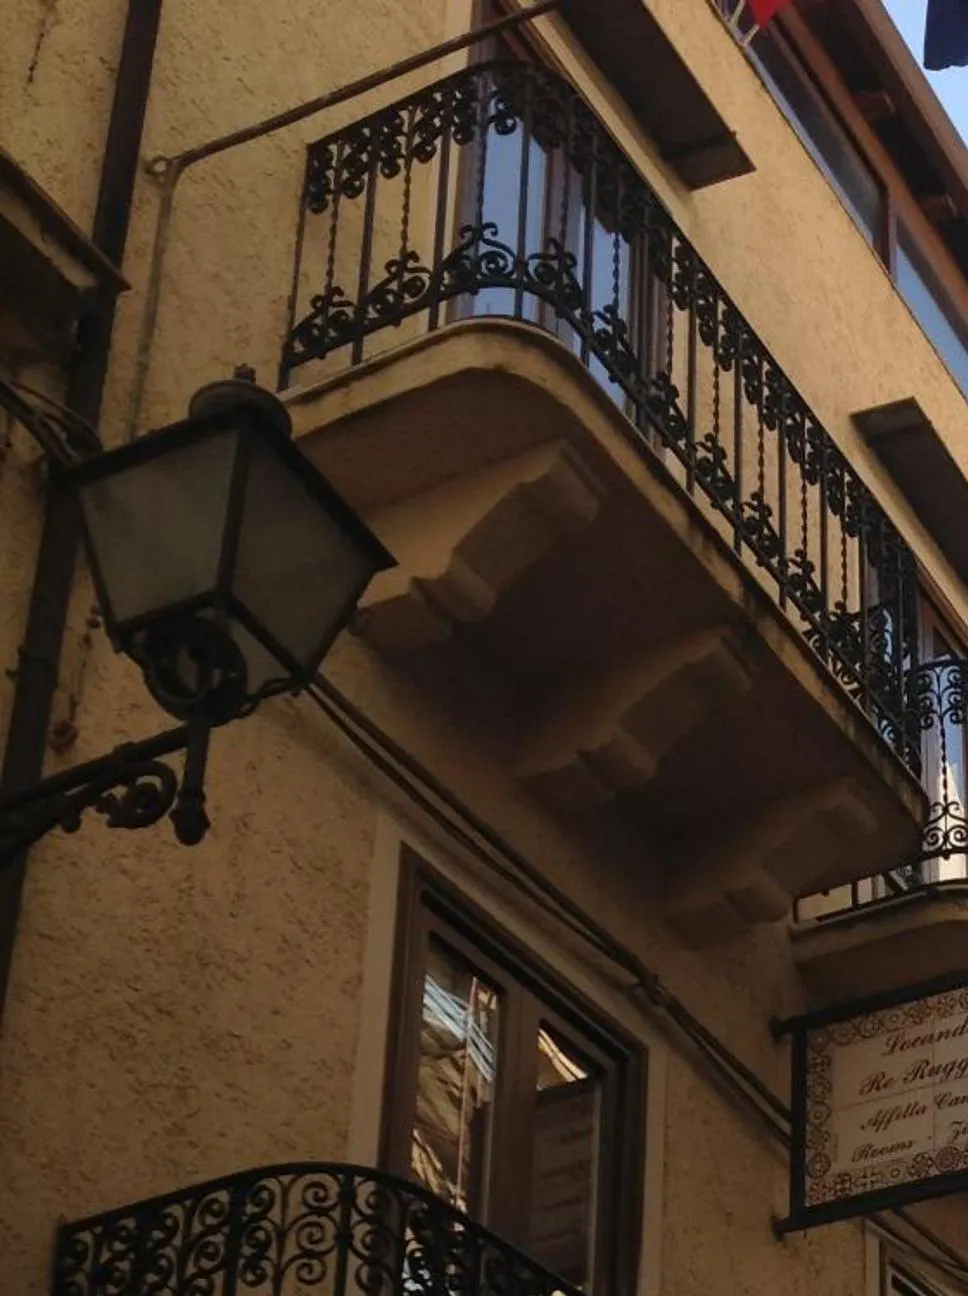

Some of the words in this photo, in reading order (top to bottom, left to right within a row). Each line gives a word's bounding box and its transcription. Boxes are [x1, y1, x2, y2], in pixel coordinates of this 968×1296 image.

[859, 1072, 897, 1095] Re
[860, 1101, 927, 1133] Affitta
[851, 1140, 914, 1163] Rooms
